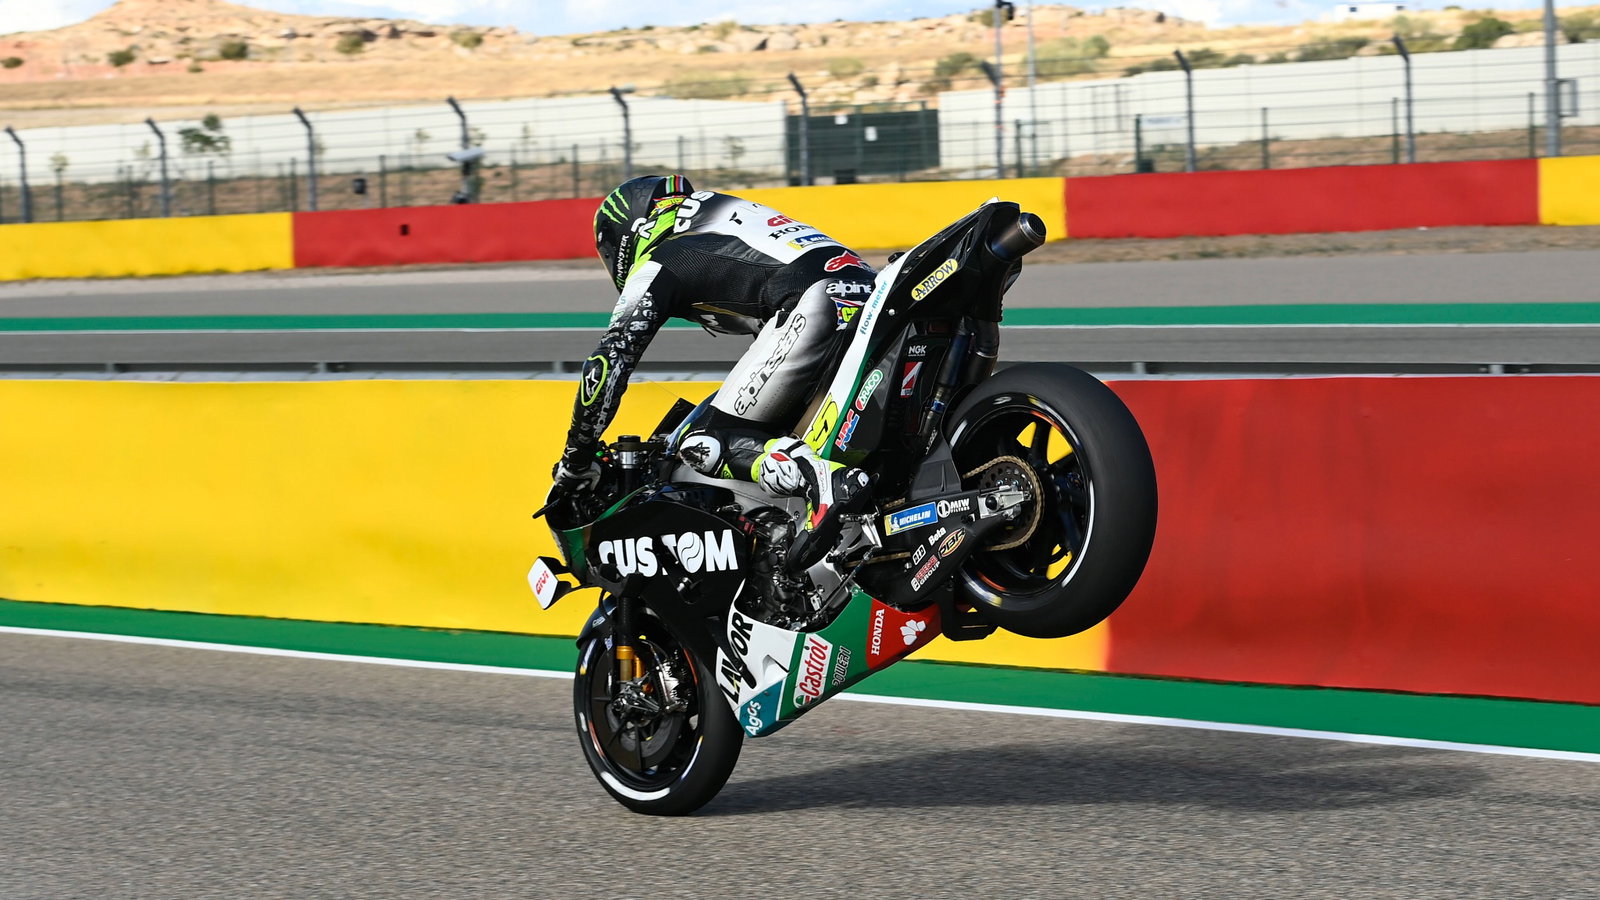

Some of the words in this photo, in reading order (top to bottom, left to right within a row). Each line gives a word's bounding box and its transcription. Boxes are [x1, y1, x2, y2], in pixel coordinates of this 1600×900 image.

[914, 261, 954, 300] ARROW
[908, 345, 928, 354] NGK
[835, 409, 860, 452] HRC
[899, 509, 931, 525] MICHELIN
[927, 527, 947, 546] Beta
[535, 570, 550, 595] GIVI
[919, 561, 940, 585] GROUP
[871, 608, 885, 656] HONDA
[799, 637, 829, 698] Castrol
[744, 700, 763, 737] Agos
